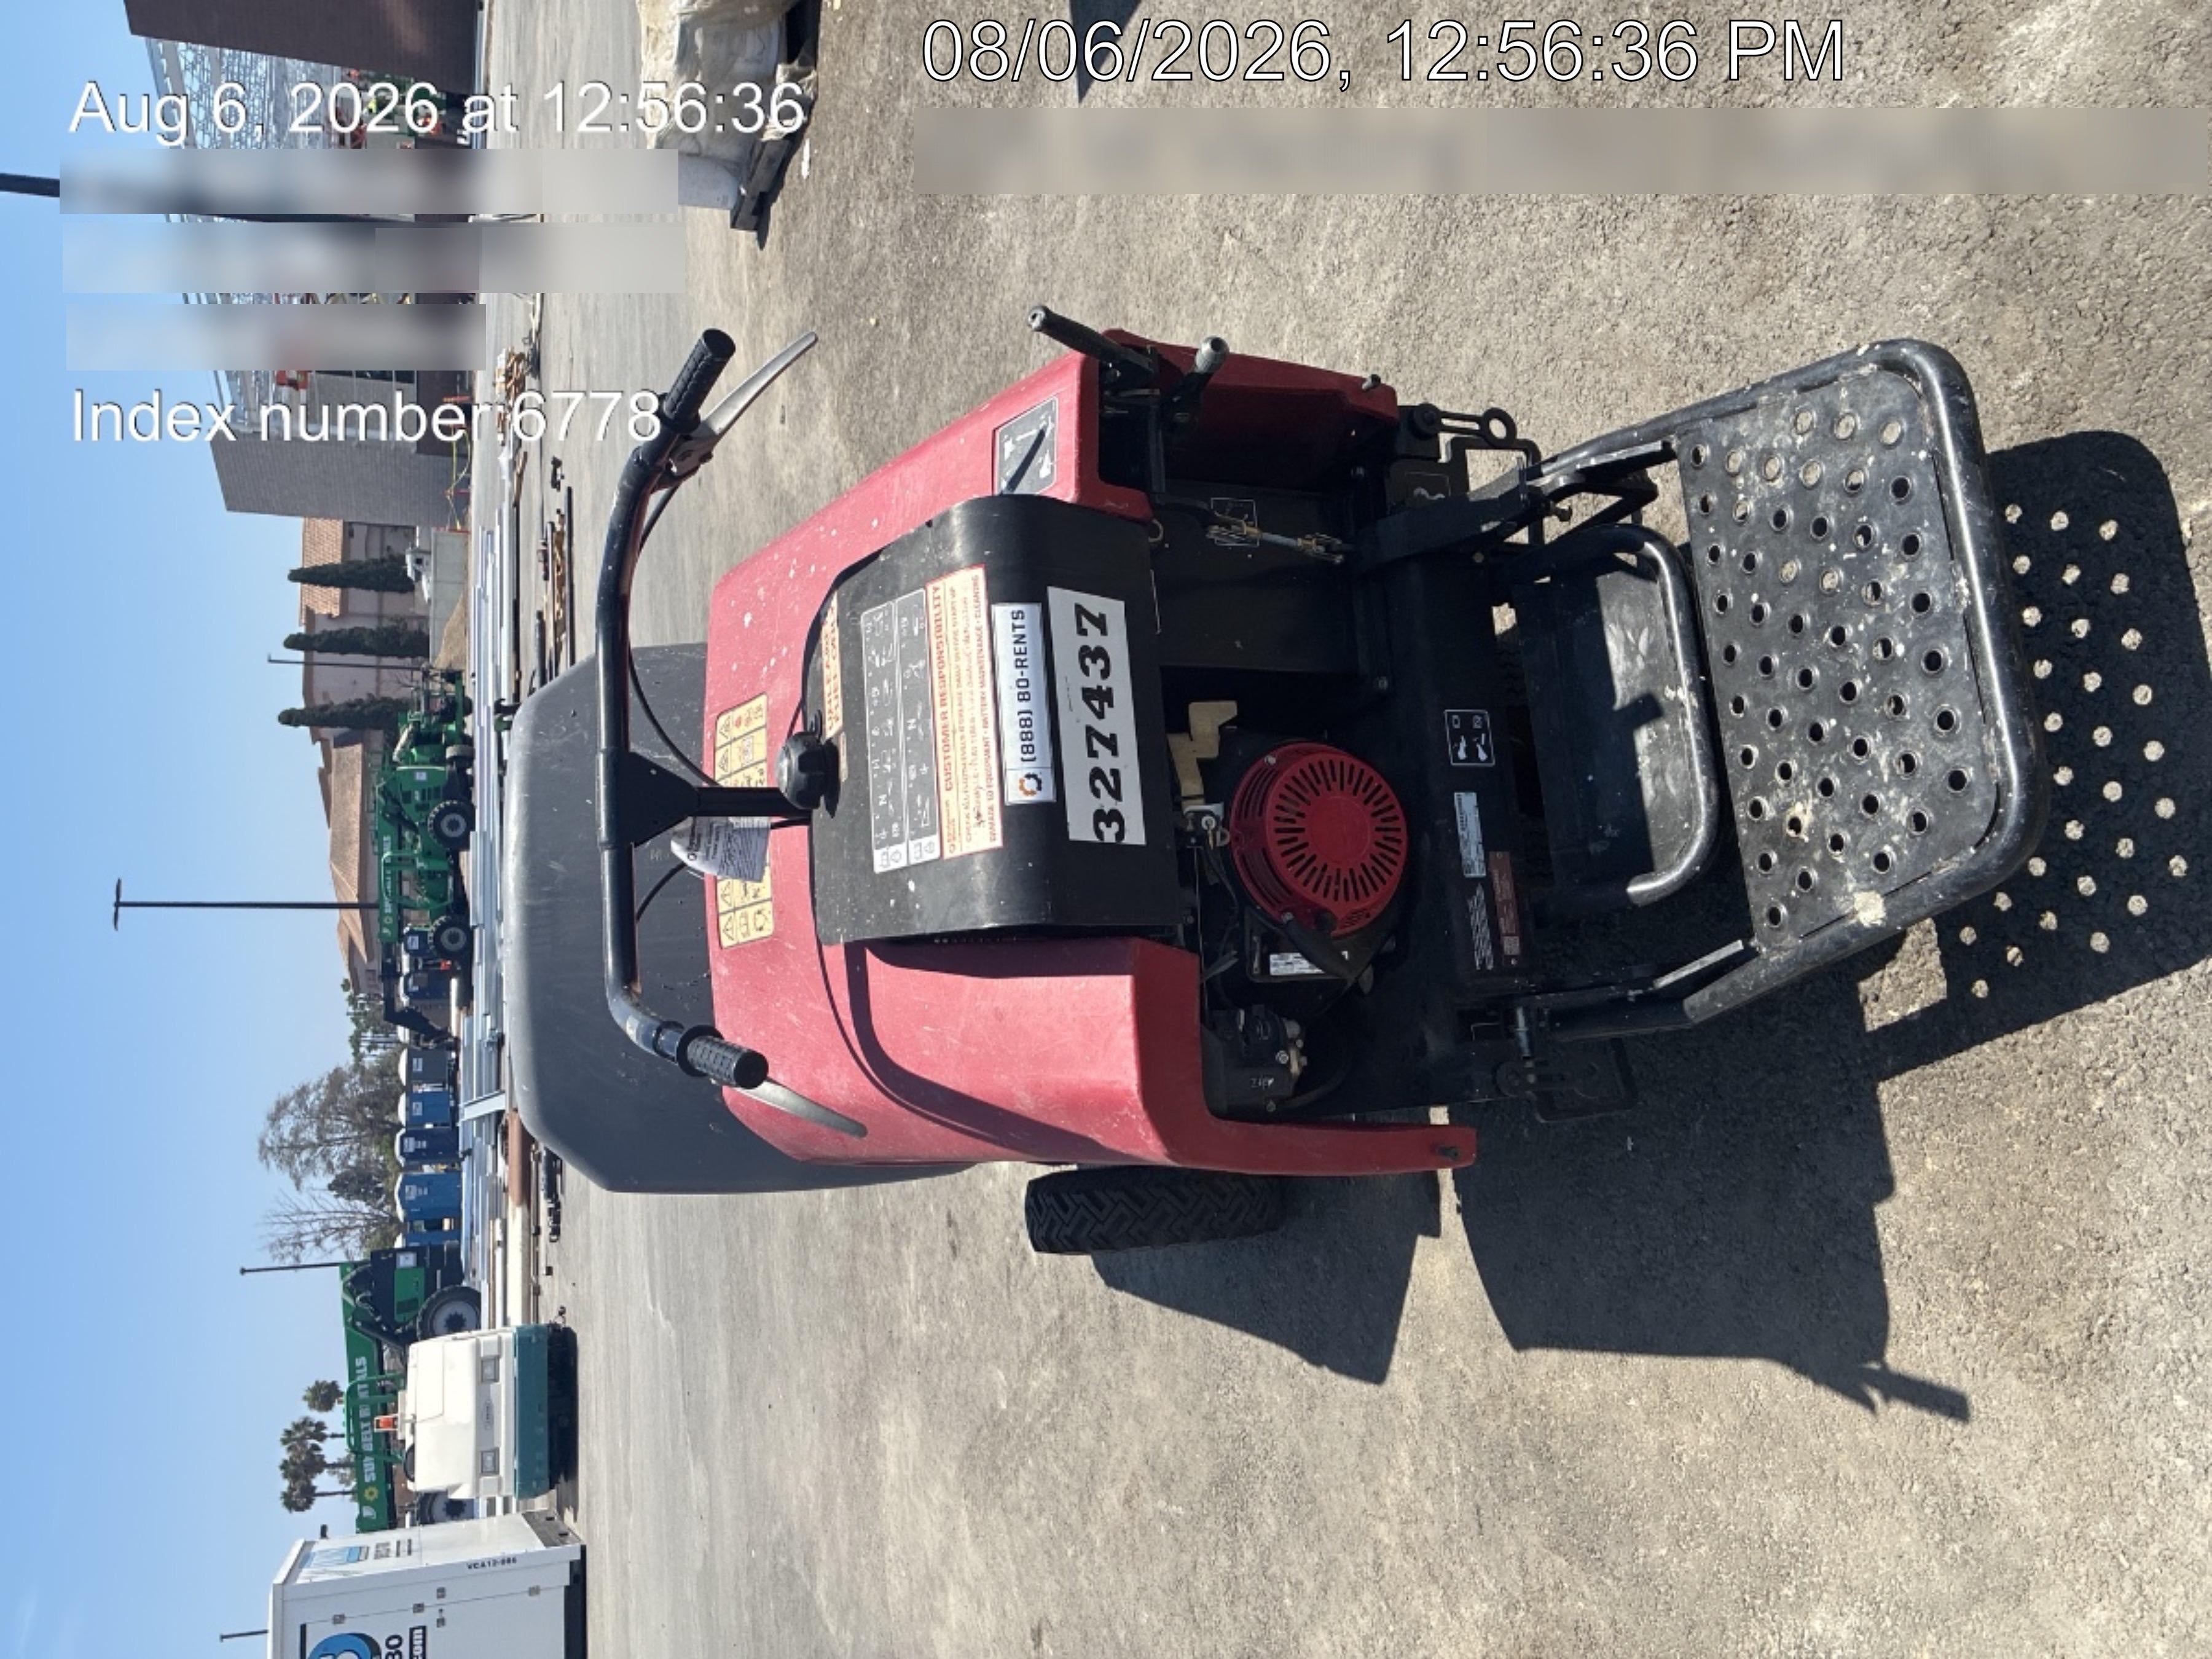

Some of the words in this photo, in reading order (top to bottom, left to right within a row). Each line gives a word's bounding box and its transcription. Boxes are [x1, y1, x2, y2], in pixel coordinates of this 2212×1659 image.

[931, 585, 947, 708] RESPONSIBILITY
[1011, 608, 1031, 703] 80-RENTS
[939, 710, 953, 793] CUSTOMER
[1018, 710, 1037, 763] (888)
[1074, 602, 1126, 843] 327437
